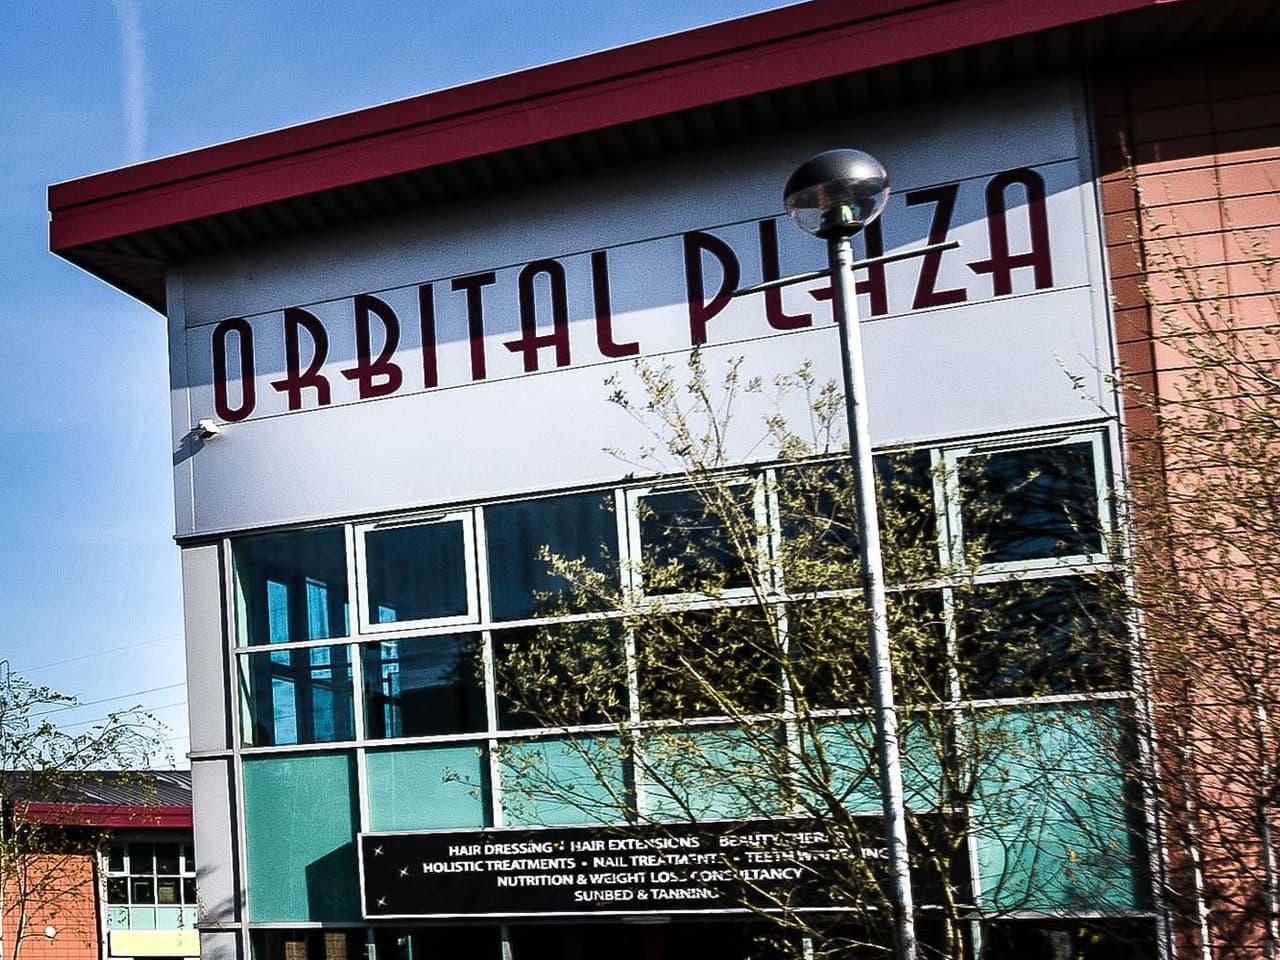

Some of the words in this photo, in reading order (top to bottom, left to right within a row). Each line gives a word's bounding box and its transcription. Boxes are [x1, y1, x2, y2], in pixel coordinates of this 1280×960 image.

[212, 251, 640, 423] ORBITAL
[682, 167, 1054, 347] PLAZA
[448, 844, 481, 856] HAIR
[484, 841, 553, 855] DRESSING
[570, 840, 605, 852] HAIR
[422, 860, 484, 873] HOLISTIC
[486, 857, 576, 872] TREATMENTS
[593, 856, 628, 868] NAIL
[496, 873, 574, 887] NUTRITION
[576, 873, 588, 885] &
[589, 871, 646, 885] WEIGHT
[573, 889, 634, 902] SUNBED
[636, 888, 649, 900] &
